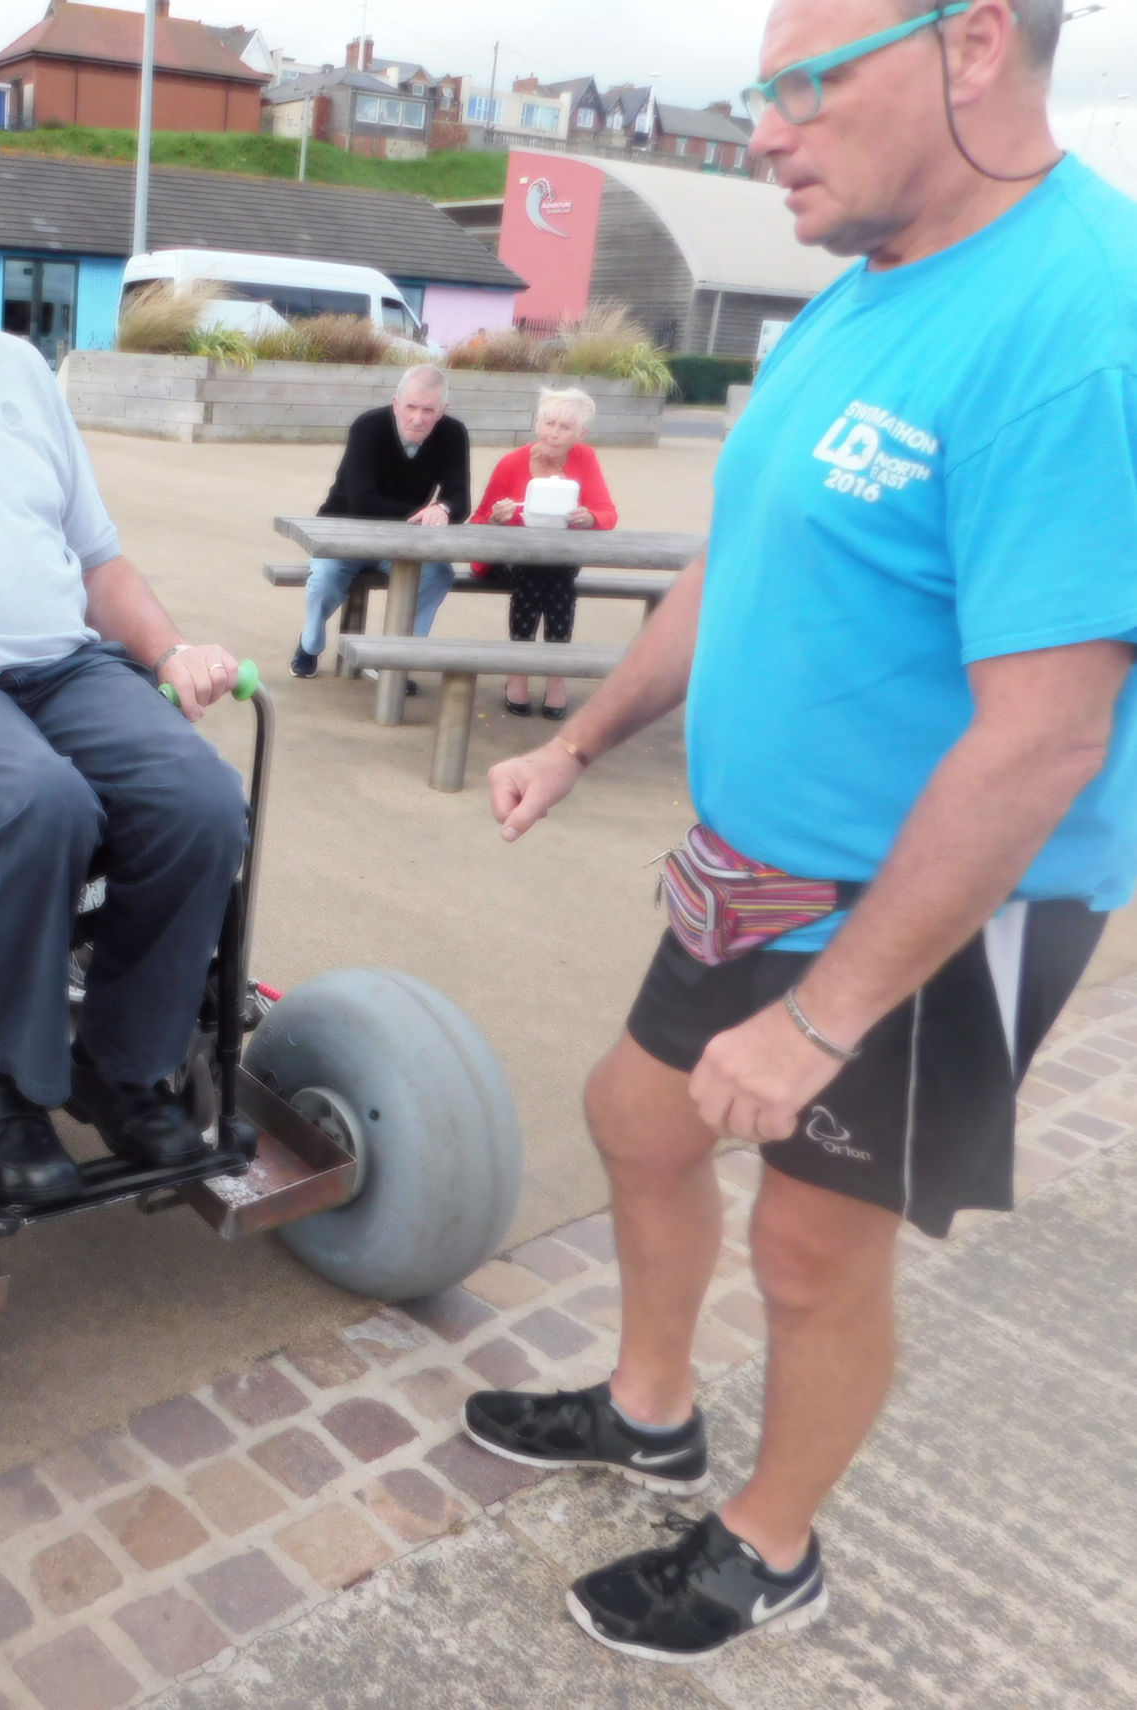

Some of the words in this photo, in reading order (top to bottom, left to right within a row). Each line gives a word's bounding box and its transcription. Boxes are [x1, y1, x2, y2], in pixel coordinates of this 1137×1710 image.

[844, 400, 938, 455] SWIMATHON
[870, 466, 910, 490] EAST
[874, 452, 932, 481] NORTH
[824, 468, 882, 503] 2016
